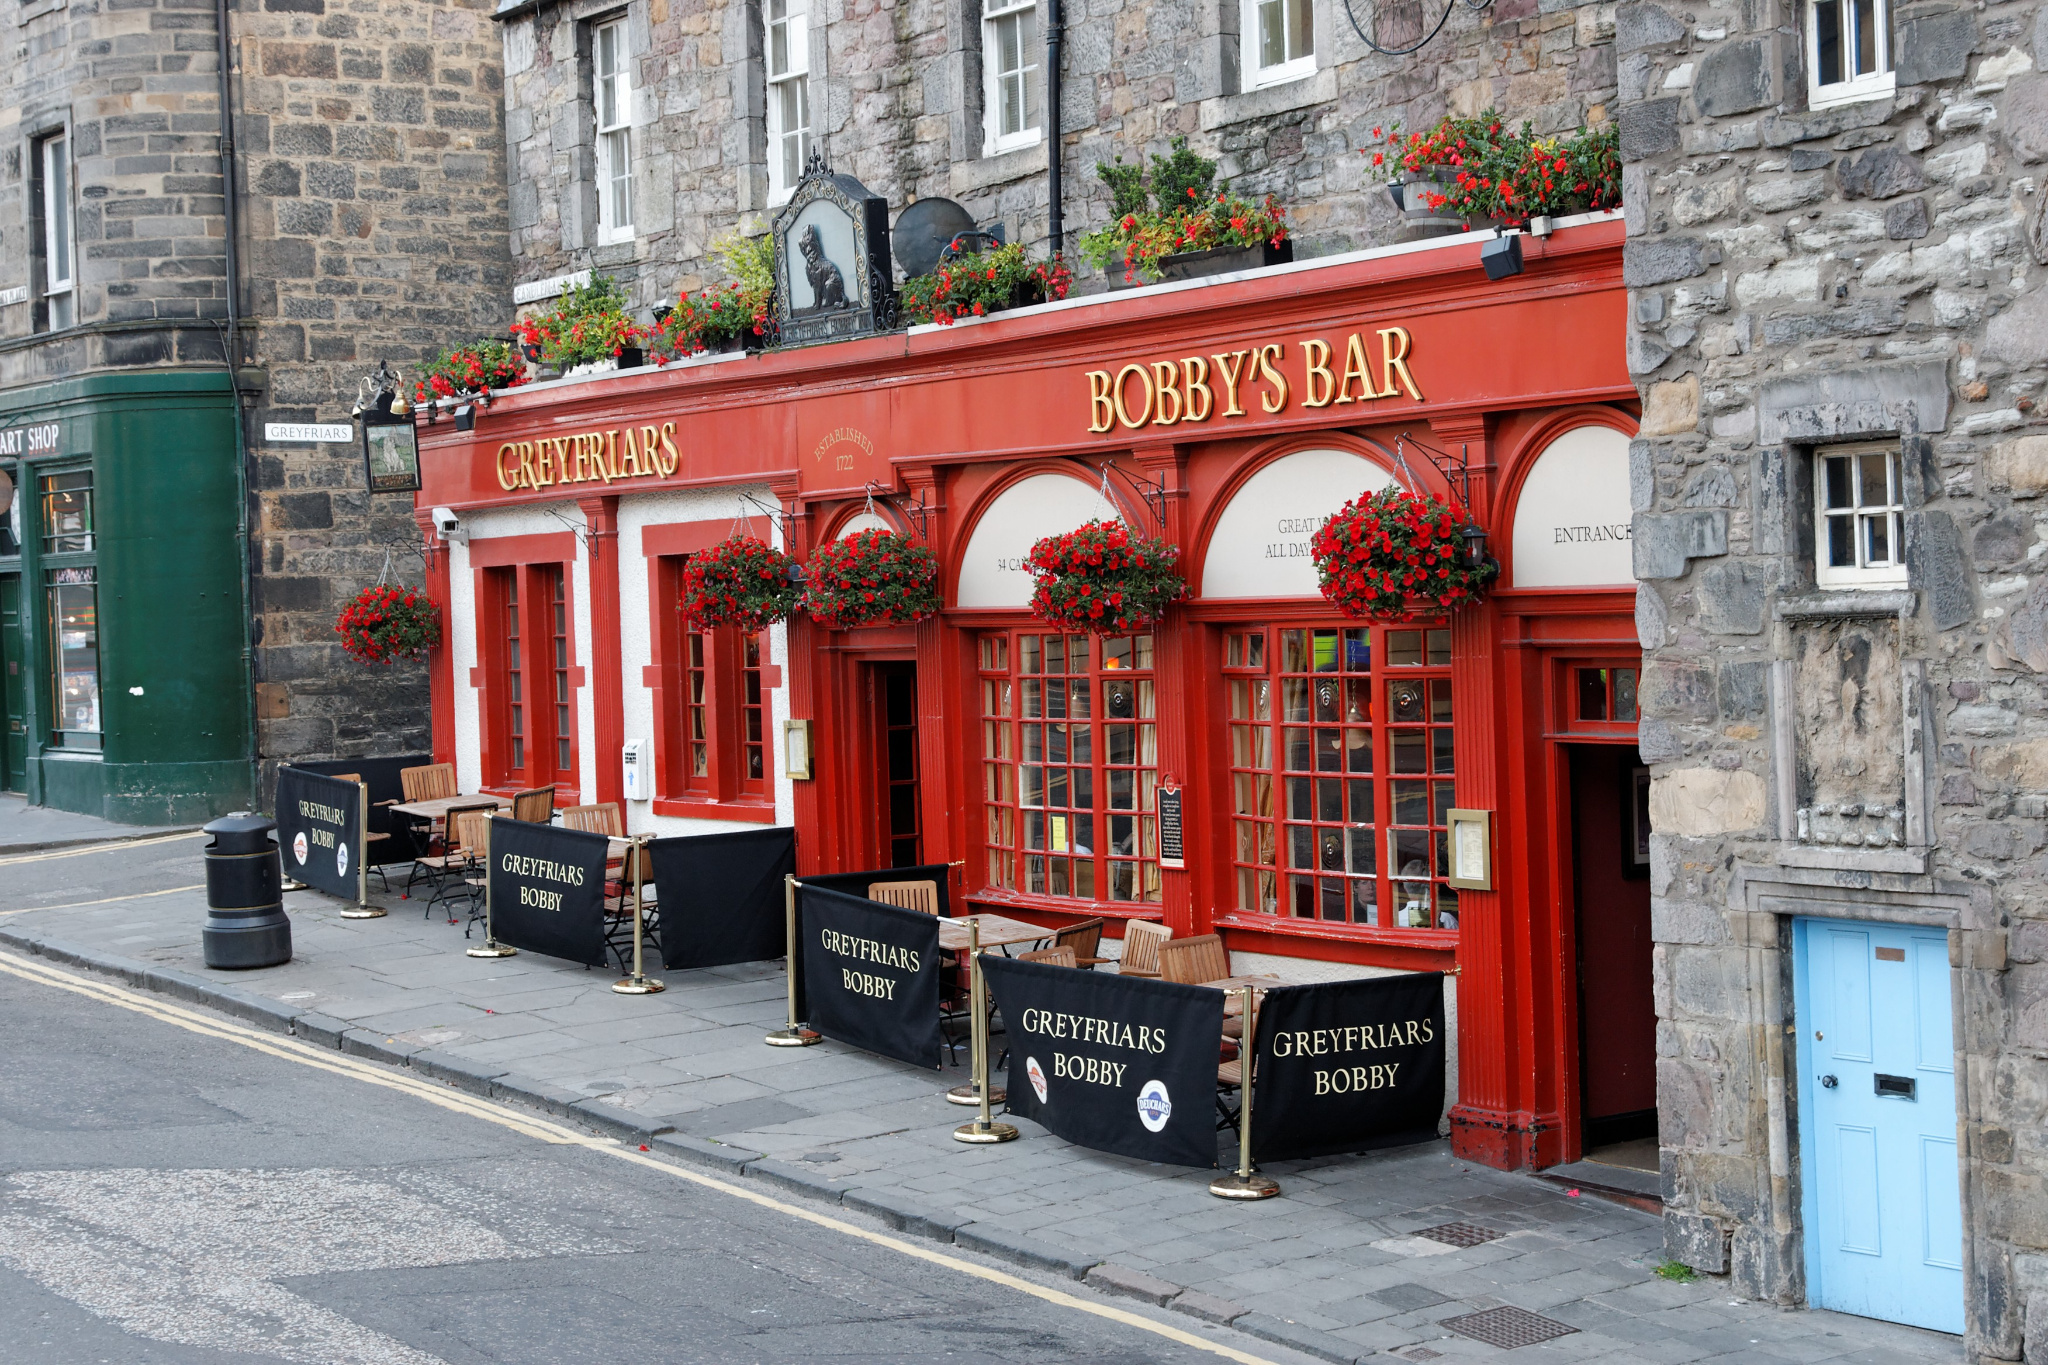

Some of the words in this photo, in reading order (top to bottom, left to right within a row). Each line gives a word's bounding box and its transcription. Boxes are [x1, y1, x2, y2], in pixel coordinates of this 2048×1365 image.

[1084, 343, 1288, 433] BOBBY'S
[1299, 326, 1424, 408] BAR
[28, 424, 59, 451] SHOP
[270, 426, 348, 439] GREYFRIARS
[814, 427, 874, 463] ESTABLISHED
[496, 421, 680, 492] GREYFRIARS
[836, 454, 854, 472] 1722
[1278, 517, 1316, 534] GREAT
[1554, 523, 1633, 544] ENTRANCE
[1265, 542, 1286, 559] ALL
[1289, 542, 1311, 557] DAY
[299, 799, 345, 826] GREYFRIARS
[311, 827, 335, 850] BOBBY
[502, 853, 584, 887] GREYFRIARS
[520, 886, 563, 912] BOBBY
[821, 928, 920, 973] GREYFRIARS
[842, 968, 896, 1000] BOBBY
[1022, 1008, 1166, 1055] GREYFRIARS
[1273, 1018, 1434, 1058] GREYFRIARS
[1053, 1052, 1127, 1088] BOBBY
[1314, 1063, 1400, 1096] BOBBY
[1139, 1099, 1169, 1114] DEUCHARS
